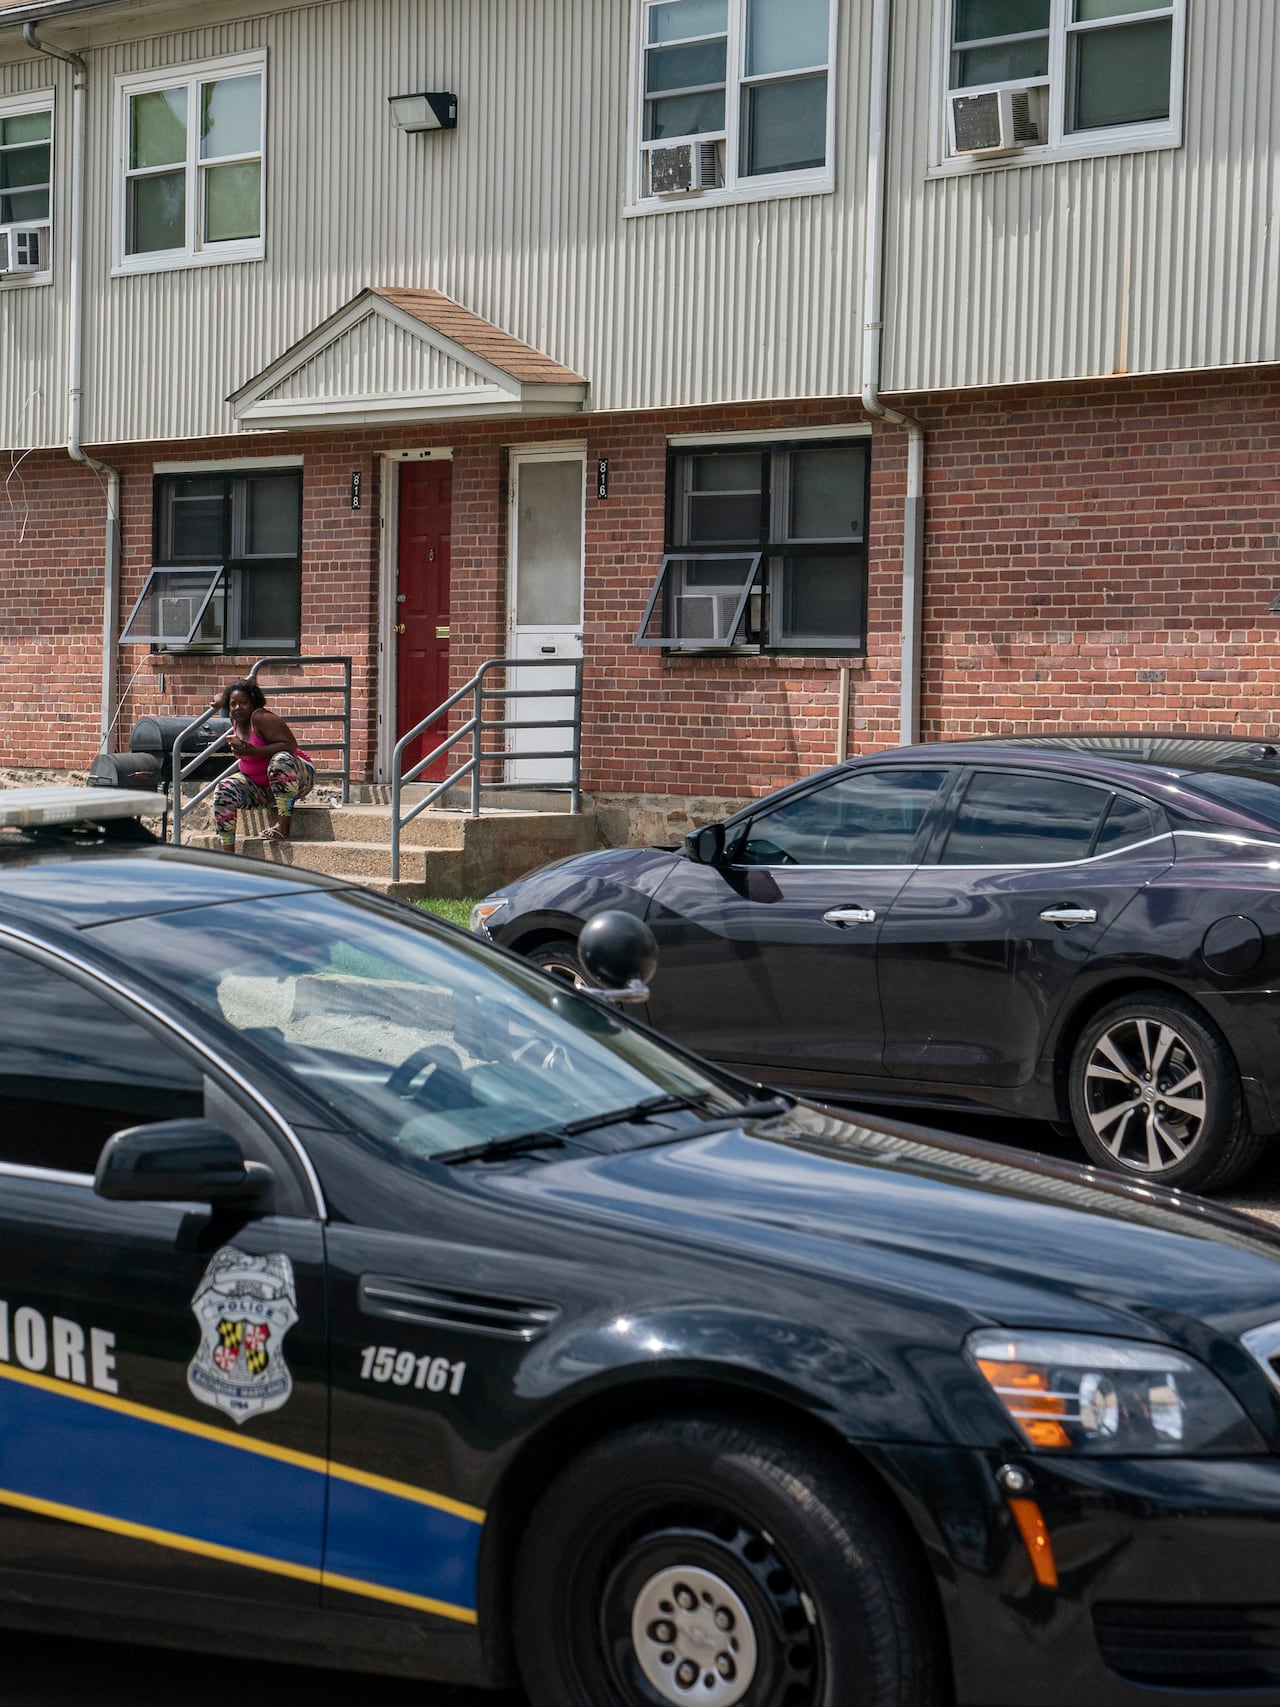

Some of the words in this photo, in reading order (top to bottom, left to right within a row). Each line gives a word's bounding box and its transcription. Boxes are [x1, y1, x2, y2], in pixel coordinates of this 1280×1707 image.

[352, 475, 360, 508] 818
[599, 462, 607, 496] 816
[217, 1301, 275, 1317] POLICE
[360, 1345, 466, 1396] 159161
